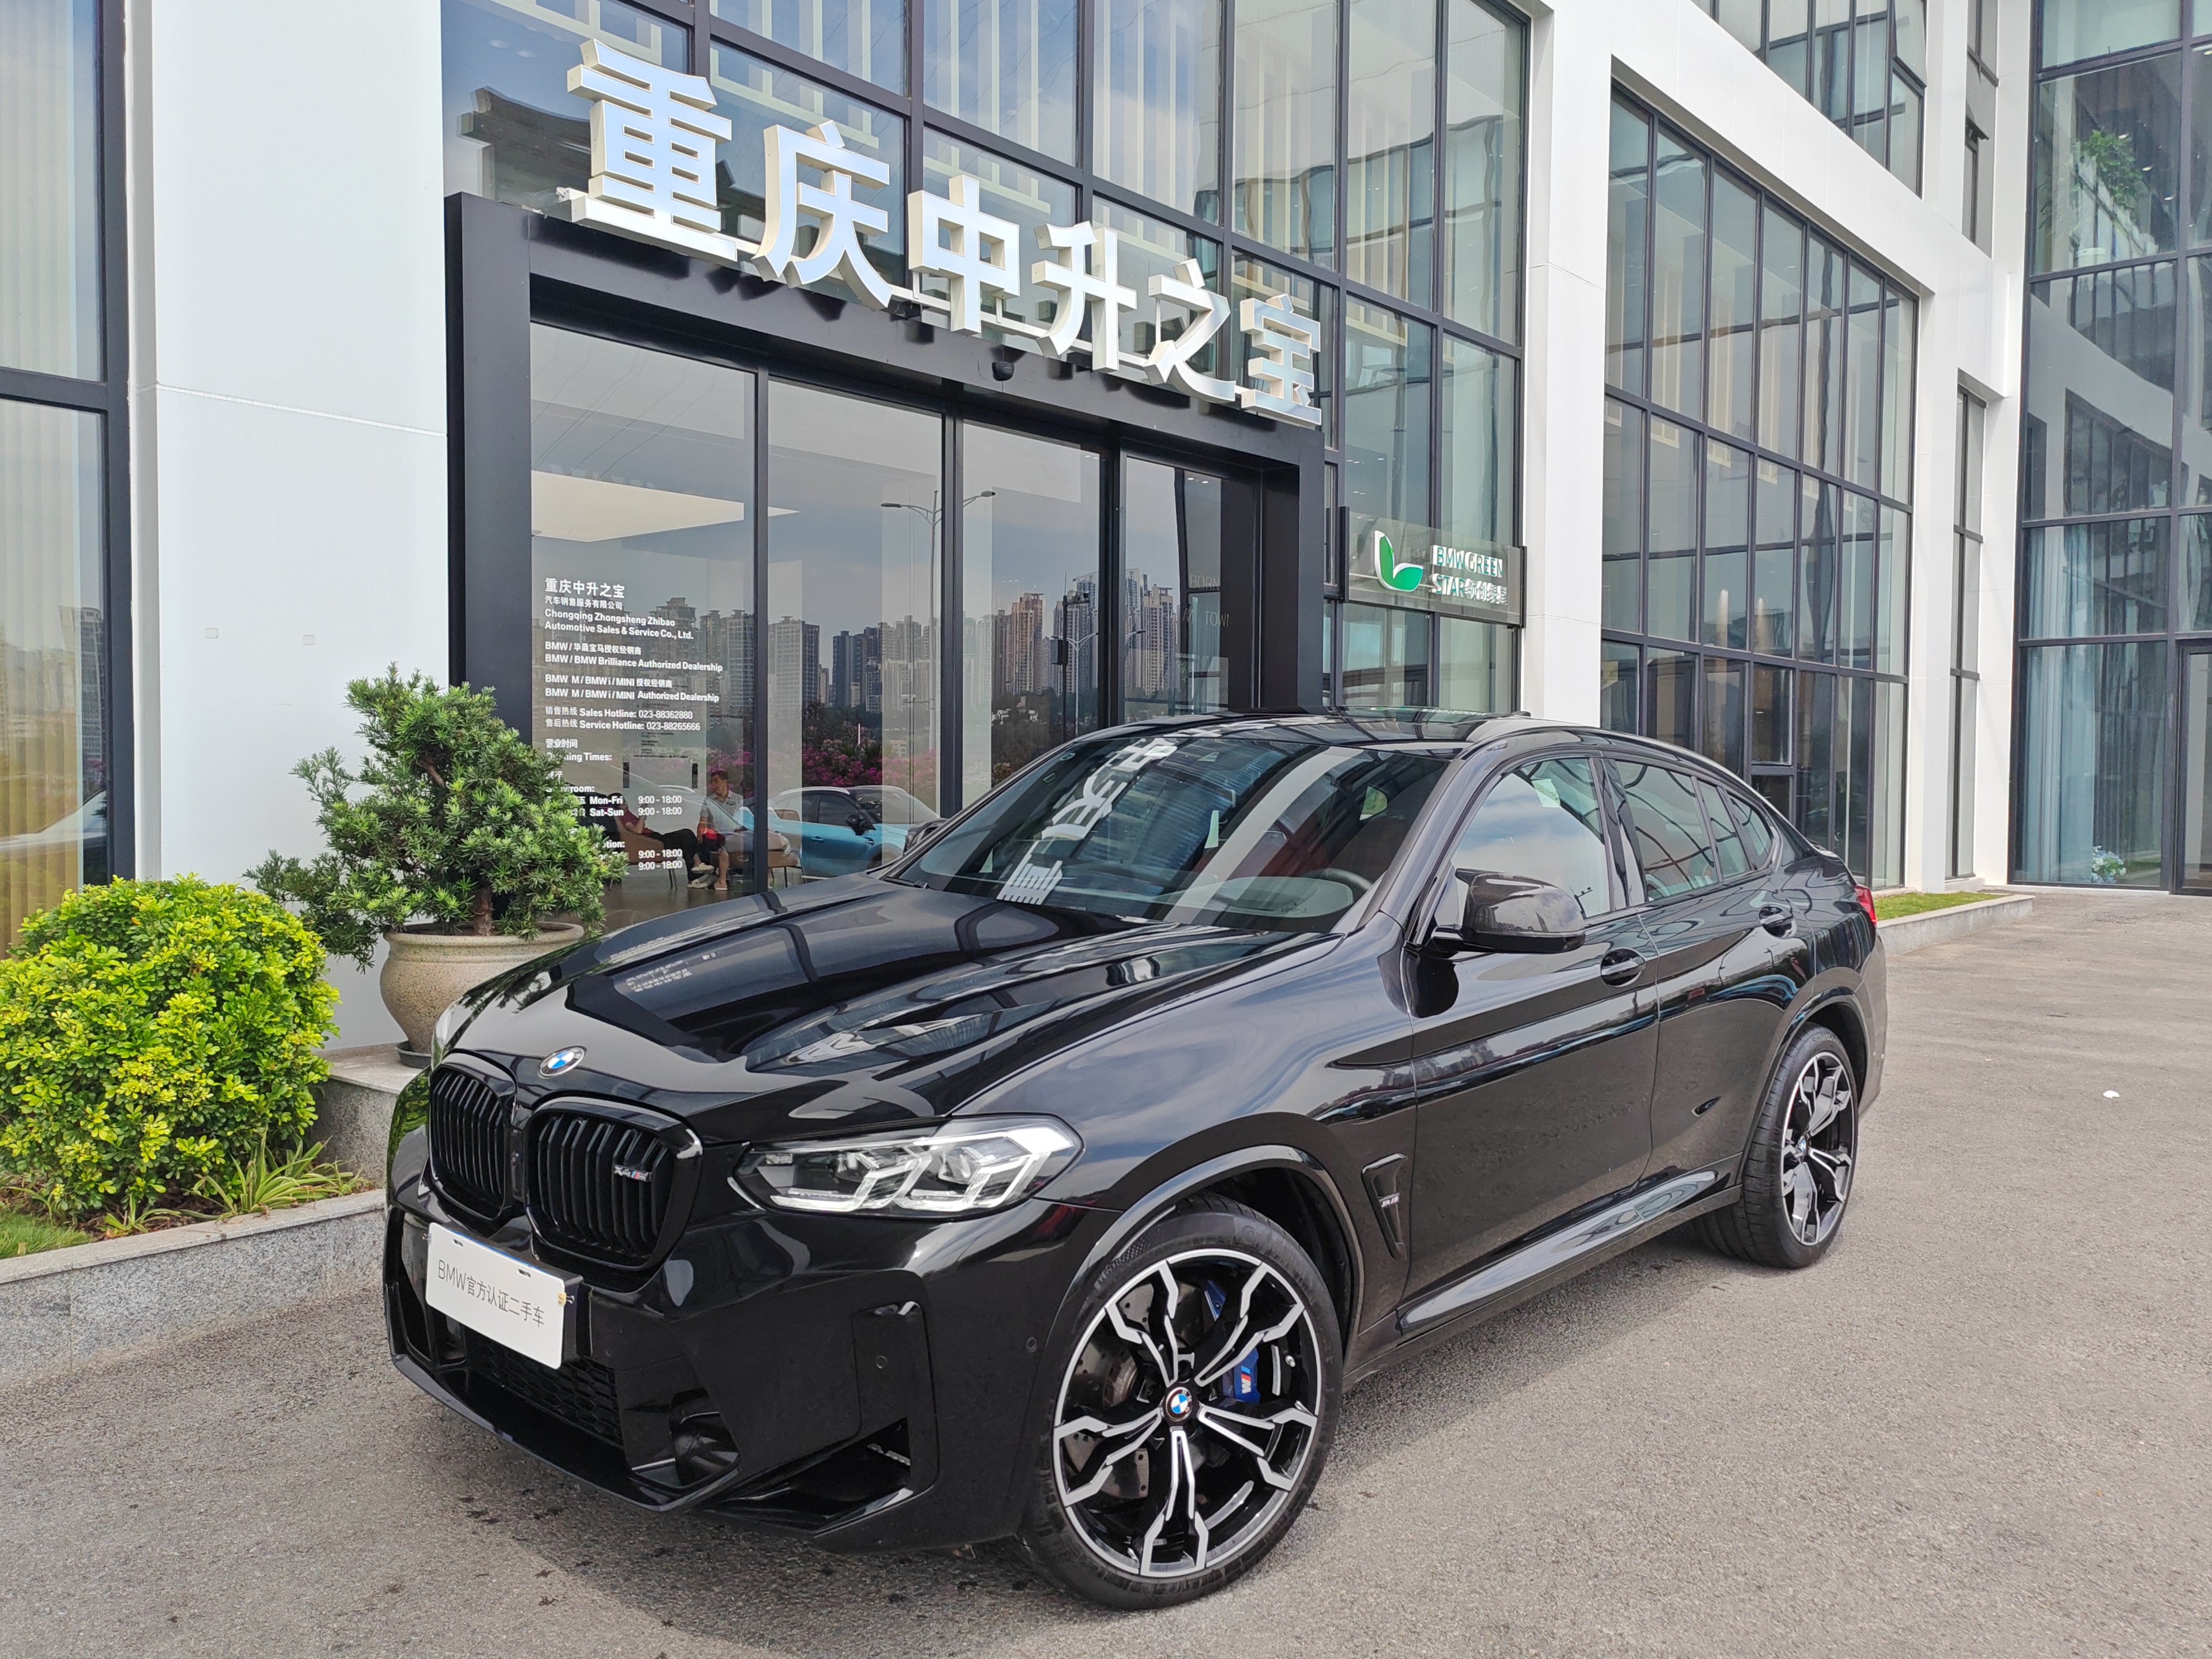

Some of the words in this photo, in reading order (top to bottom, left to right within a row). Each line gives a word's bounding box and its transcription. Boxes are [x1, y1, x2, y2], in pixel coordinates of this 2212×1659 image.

[568, 38, 1321, 426] 重庆中升之宝
[1433, 545, 1464, 570] BMW
[1465, 551, 1503, 578] GREEN
[544, 577, 625, 598] 重庆中升之宝
[1190, 574, 1220, 591] BORN
[544, 595, 623, 610] 汽车销售服务有限公司
[544, 609, 593, 622] Chongqing
[594, 612, 646, 626] Zhongsheng
[648, 616, 676, 626] Zhibao
[544, 621, 595, 632] Automotive
[597, 625, 620, 634] Sales
[629, 627, 659, 637] Service
[678, 630, 694, 639] Ltd.
[545, 654, 569, 663] BMW
[574, 656, 597, 665] BMW
[598, 657, 637, 667] Brilliance
[638, 659, 681, 670] Authorized
[682, 662, 723, 673] Dealership
[545, 674, 569, 683] BMW
[636, 678, 672, 689] 授权经销商
[545, 688, 569, 697] BMW
[637, 690, 679, 700] Authorized
[680, 692, 719, 703] Dealership
[545, 706, 578, 716] 销售热线
[579, 708, 603, 717] Sales
[604, 709, 637, 718] Hotline:
[545, 718, 578, 728] 售后热线
[579, 720, 611, 729] Service
[612, 721, 645, 730] Hotline:
[646, 721, 700, 731] 023-88265666
[545, 739, 578, 748] 营业时间
[583, 752, 612, 761] Times:
[589, 796, 623, 804] Mon-Fri
[638, 795, 655, 804] 9:00
[662, 795, 682, 804] 18:00
[589, 808, 624, 816] Sat-Sun
[638, 807, 655, 815] 9:00
[662, 807, 682, 815] 18:00
[638, 850, 655, 859] 9:00
[662, 849, 682, 858] 18:00
[638, 862, 655, 871] 9:00
[662, 861, 682, 869] 18:00
[438, 1259, 544, 1327] BMW官方认证二手车
